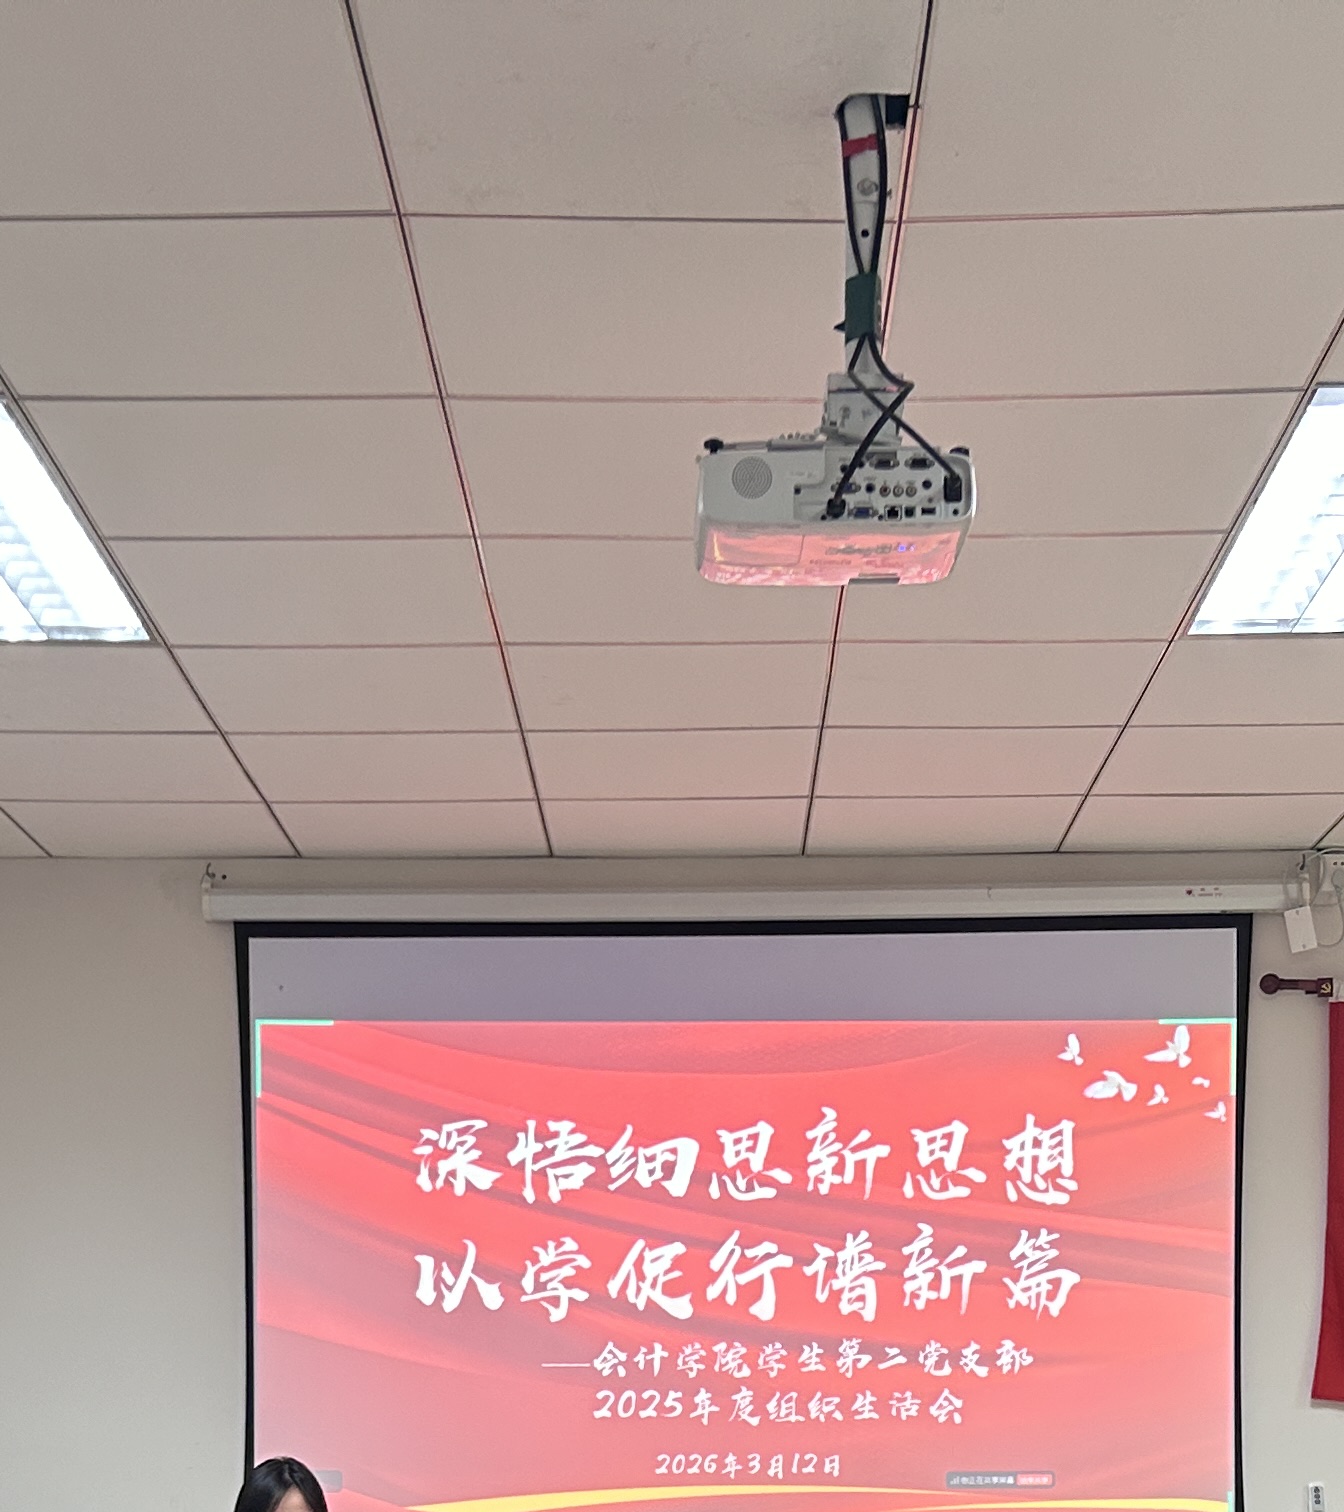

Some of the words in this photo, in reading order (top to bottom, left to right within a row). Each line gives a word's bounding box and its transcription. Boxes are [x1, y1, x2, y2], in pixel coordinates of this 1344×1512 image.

[413, 1106, 1080, 1206] 深悟细思新思想
[414, 1221, 1082, 1323] 以学促行谱新篇
[592, 1387, 965, 1426] 2025年度组织生活会
[654, 1451, 842, 1479] 2026年3月12日
